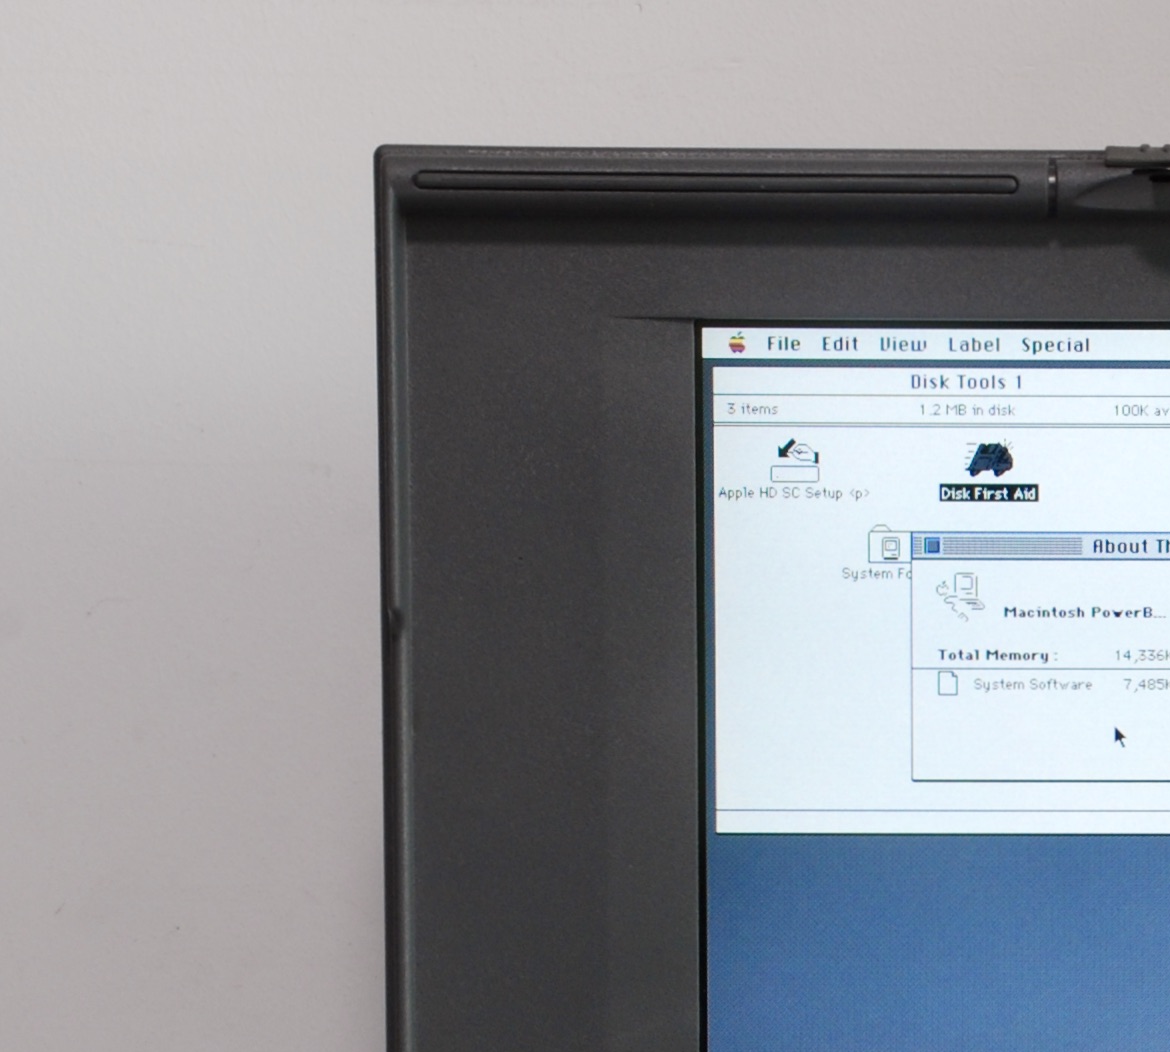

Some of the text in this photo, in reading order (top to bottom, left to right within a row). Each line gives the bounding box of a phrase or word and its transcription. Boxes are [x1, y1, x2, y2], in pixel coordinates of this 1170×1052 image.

[768, 336, 1089, 355] File Edit View Label Special
[911, 374, 1021, 389] Disk Tools 1
[727, 403, 778, 415] 3 items
[920, 404, 1015, 416] 1.2 MB in disk
[1115, 404, 1148, 416] 100K
[718, 487, 869, 502] Apple HD SC Setup <p>
[942, 486, 1036, 500] Disk First Aid
[1093, 539, 1147, 553] About
[842, 567, 893, 582] System
[1004, 607, 1084, 618] Macintosh
[939, 649, 979, 660] Total
[974, 678, 1025, 693] System
[1030, 678, 1092, 690] Software
